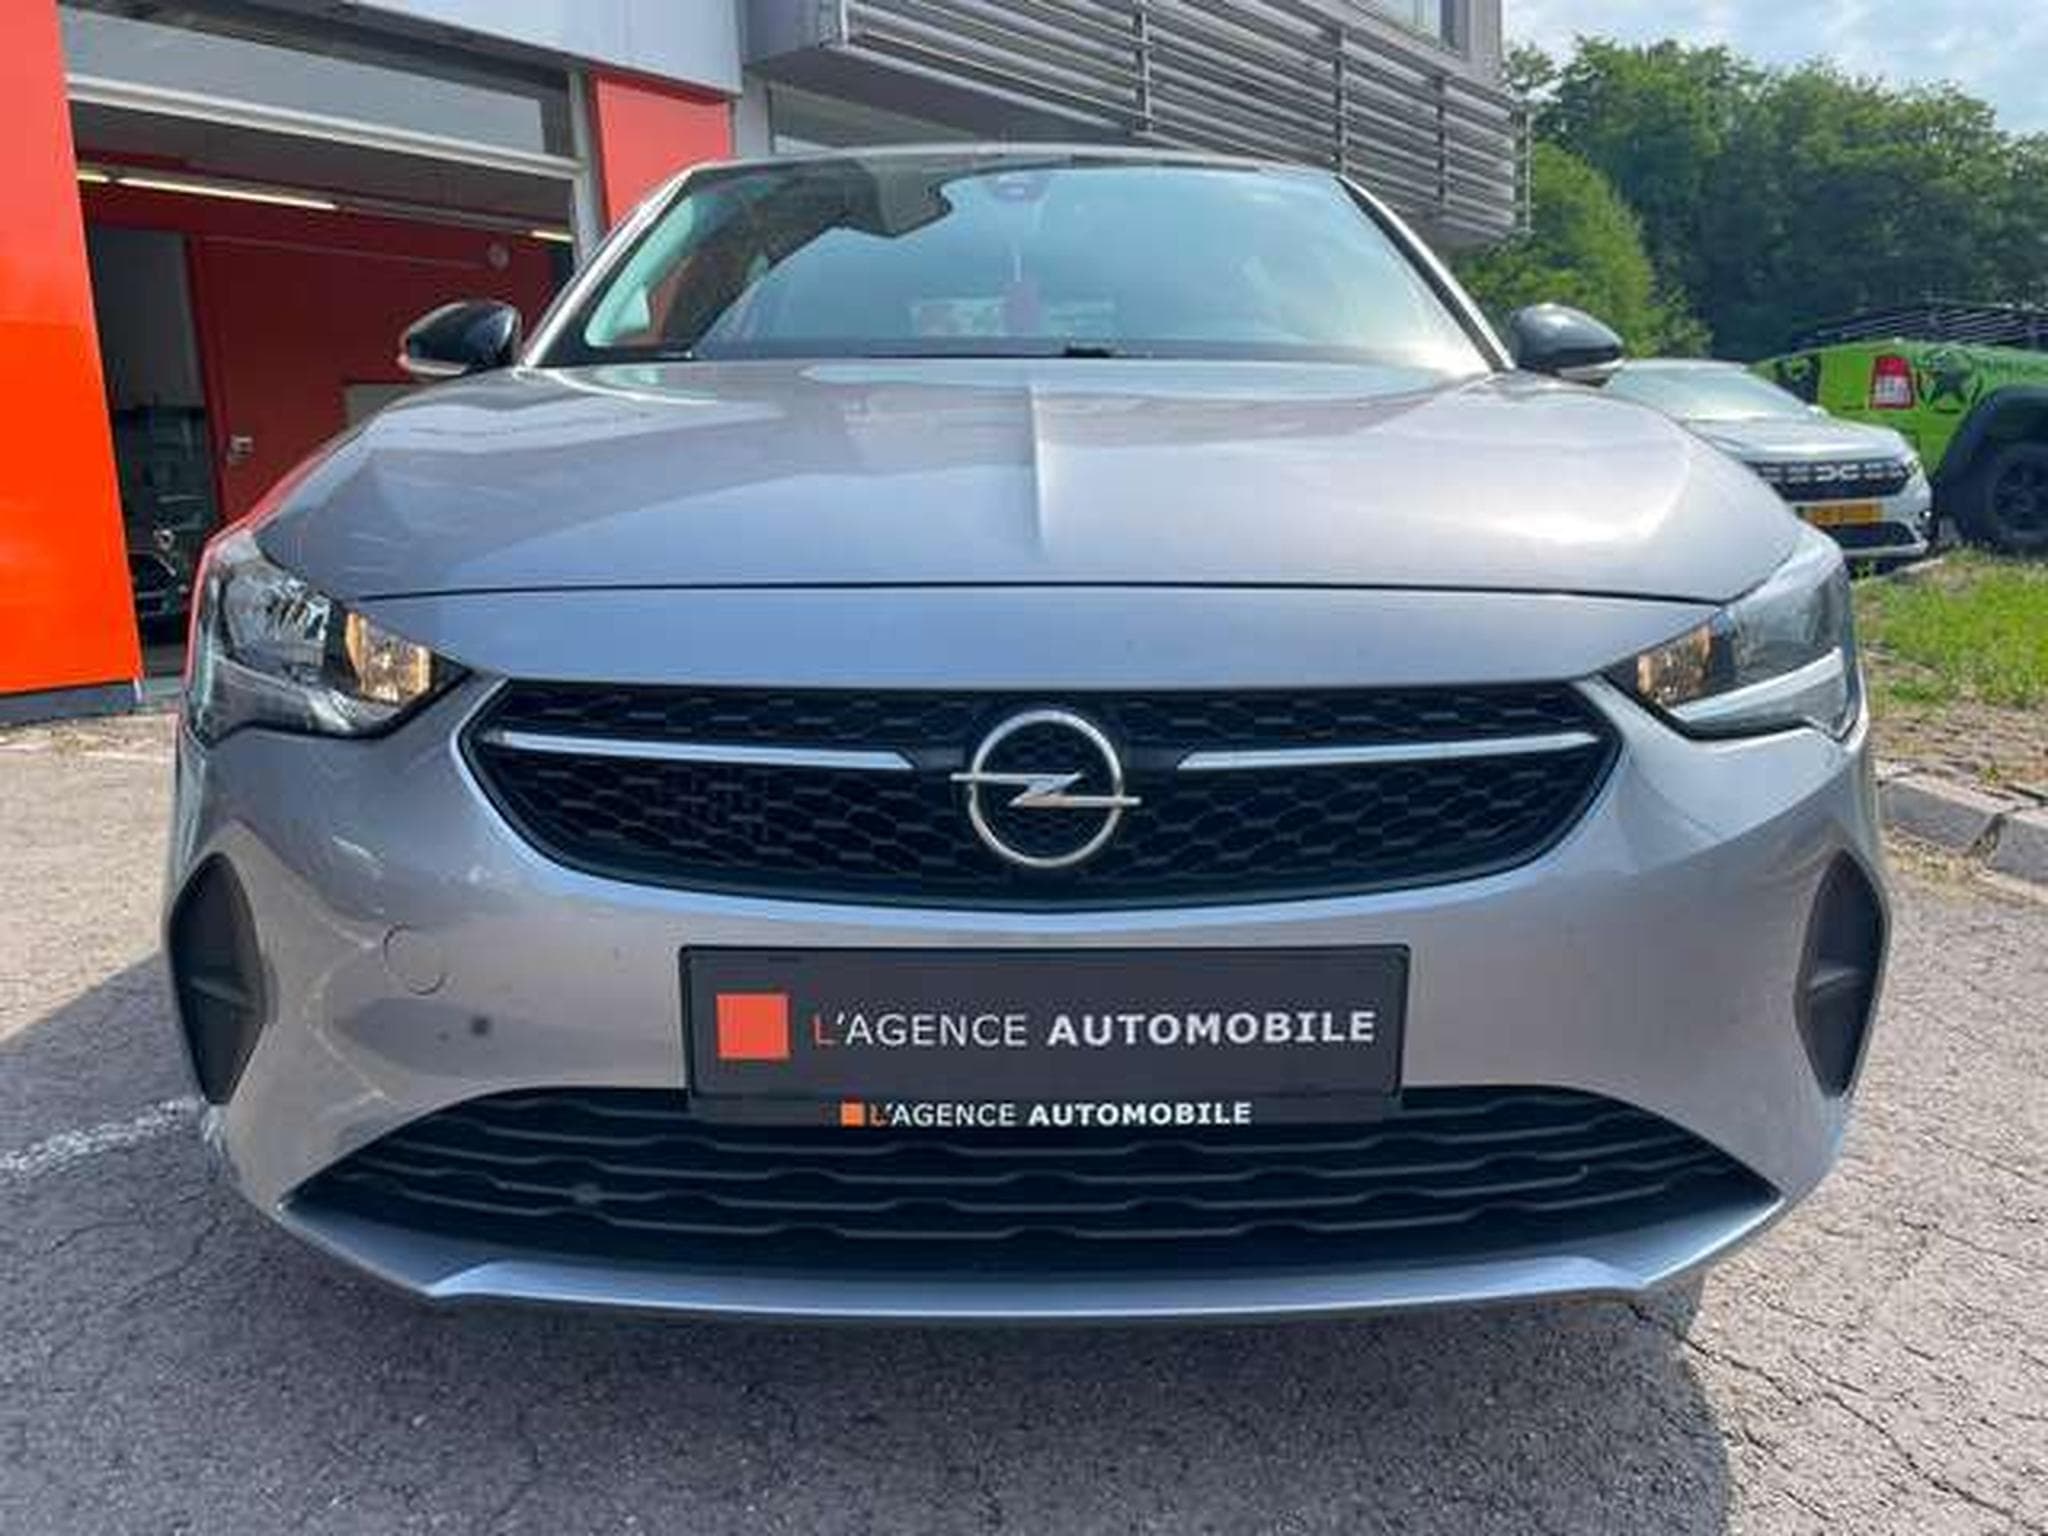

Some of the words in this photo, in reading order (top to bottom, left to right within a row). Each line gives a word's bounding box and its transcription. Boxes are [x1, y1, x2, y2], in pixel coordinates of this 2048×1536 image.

[813, 1012, 1028, 1047] L'AGENCE
[1047, 1010, 1377, 1047] AUTOMOBILE
[870, 1102, 1016, 1127] L'AGENCE
[1029, 1102, 1252, 1127] AUTOMOBILE
